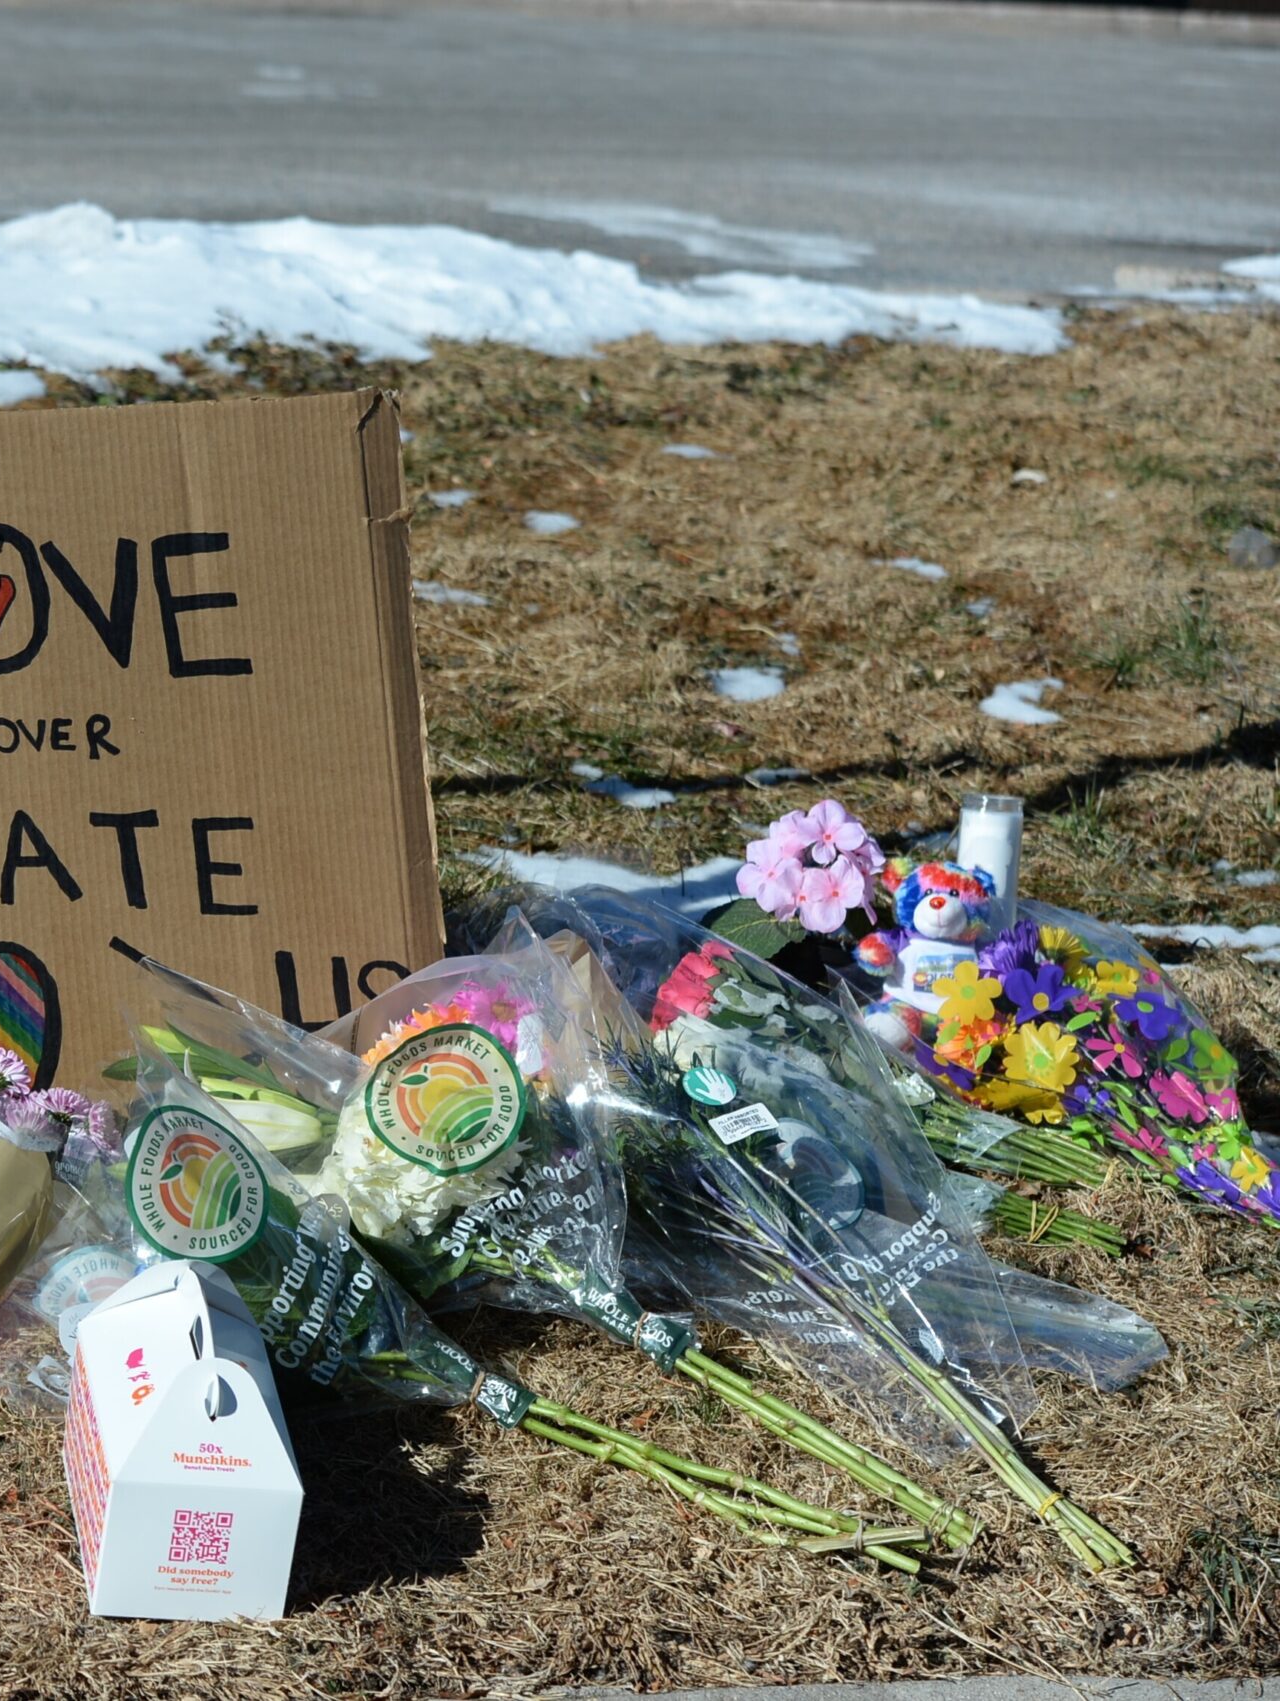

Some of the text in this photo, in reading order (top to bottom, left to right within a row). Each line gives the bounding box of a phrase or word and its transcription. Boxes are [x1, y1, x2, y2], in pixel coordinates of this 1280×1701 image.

[378, 1035, 491, 1130] WHOLE FOODS MARKET
[481, 1123, 505, 1150] FOR
[498, 1085, 513, 1123] GOOD
[141, 1130, 166, 1176] FOODS
[139, 1183, 167, 1233] WHOLE
[188, 1143, 258, 1250] SOURCED FOR GOOD
[587, 1287, 631, 1324] WHOLE
[199, 1443, 223, 1454] 50x
[157, 1565, 234, 1579] Did somebody
[170, 1577, 219, 1585] say free?
